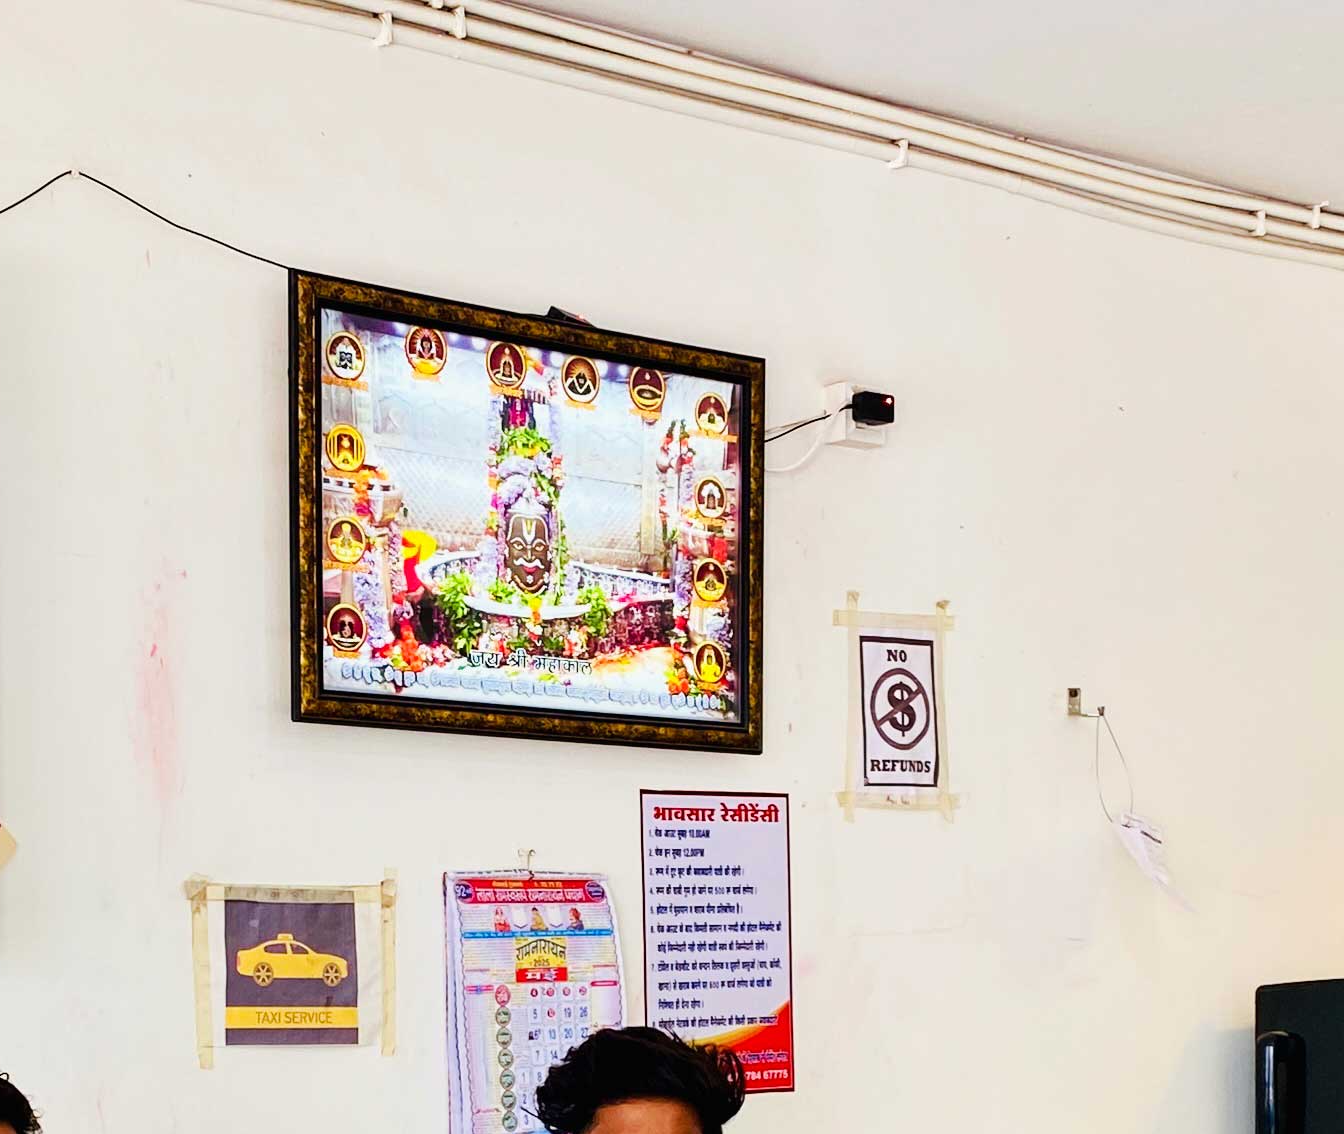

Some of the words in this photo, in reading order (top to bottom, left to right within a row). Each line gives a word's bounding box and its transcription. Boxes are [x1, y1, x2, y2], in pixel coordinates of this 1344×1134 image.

[886, 649, 908, 662] NO
[534, 655, 592, 675] महाकाल
[870, 759, 931, 773] REFUNDS
[653, 806, 715, 821] भावसार
[720, 803, 779, 822] रेसीडेंसी
[256, 1011, 281, 1024] TAXI
[285, 1011, 333, 1024] SERVICE
